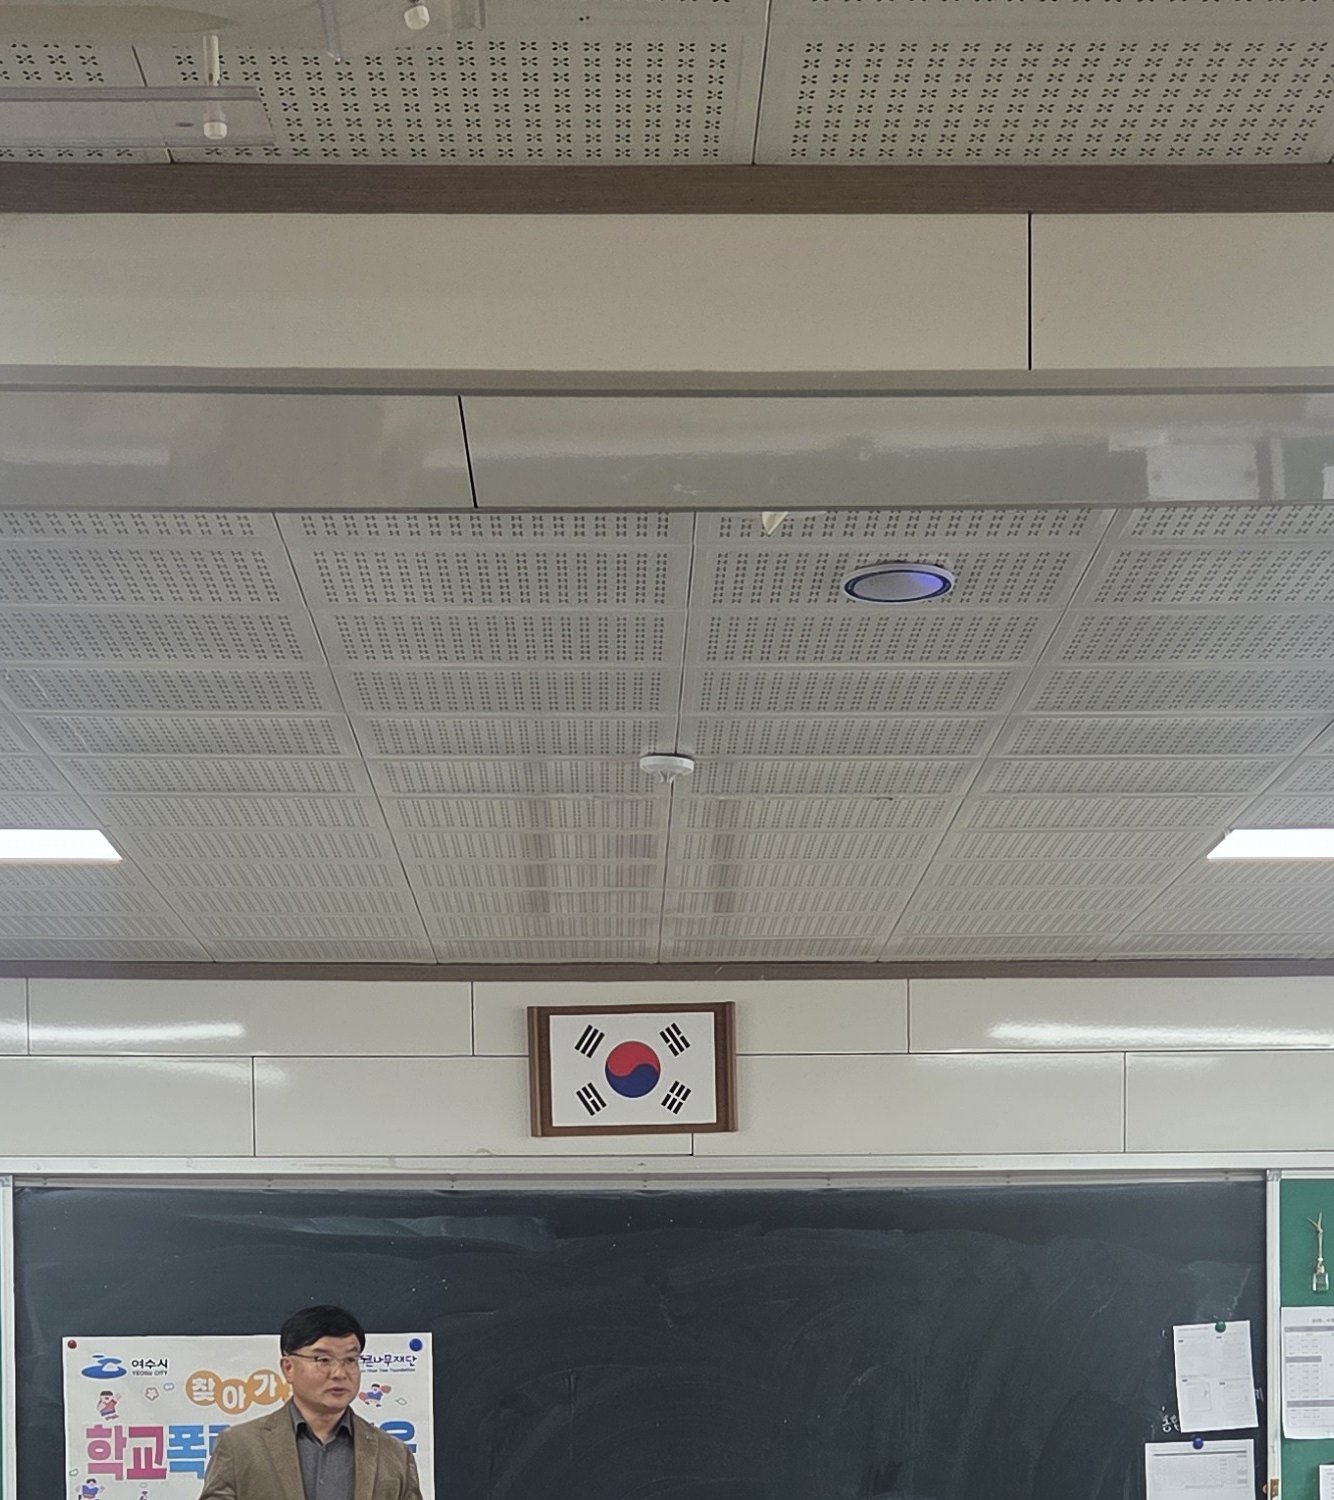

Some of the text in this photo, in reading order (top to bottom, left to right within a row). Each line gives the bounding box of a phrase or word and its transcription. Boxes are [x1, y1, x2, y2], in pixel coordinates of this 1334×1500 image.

[131, 1358, 168, 1369] 여수시
[191, 1371, 292, 1412] 찾아가
[85, 1423, 230, 1482] 학교폭
